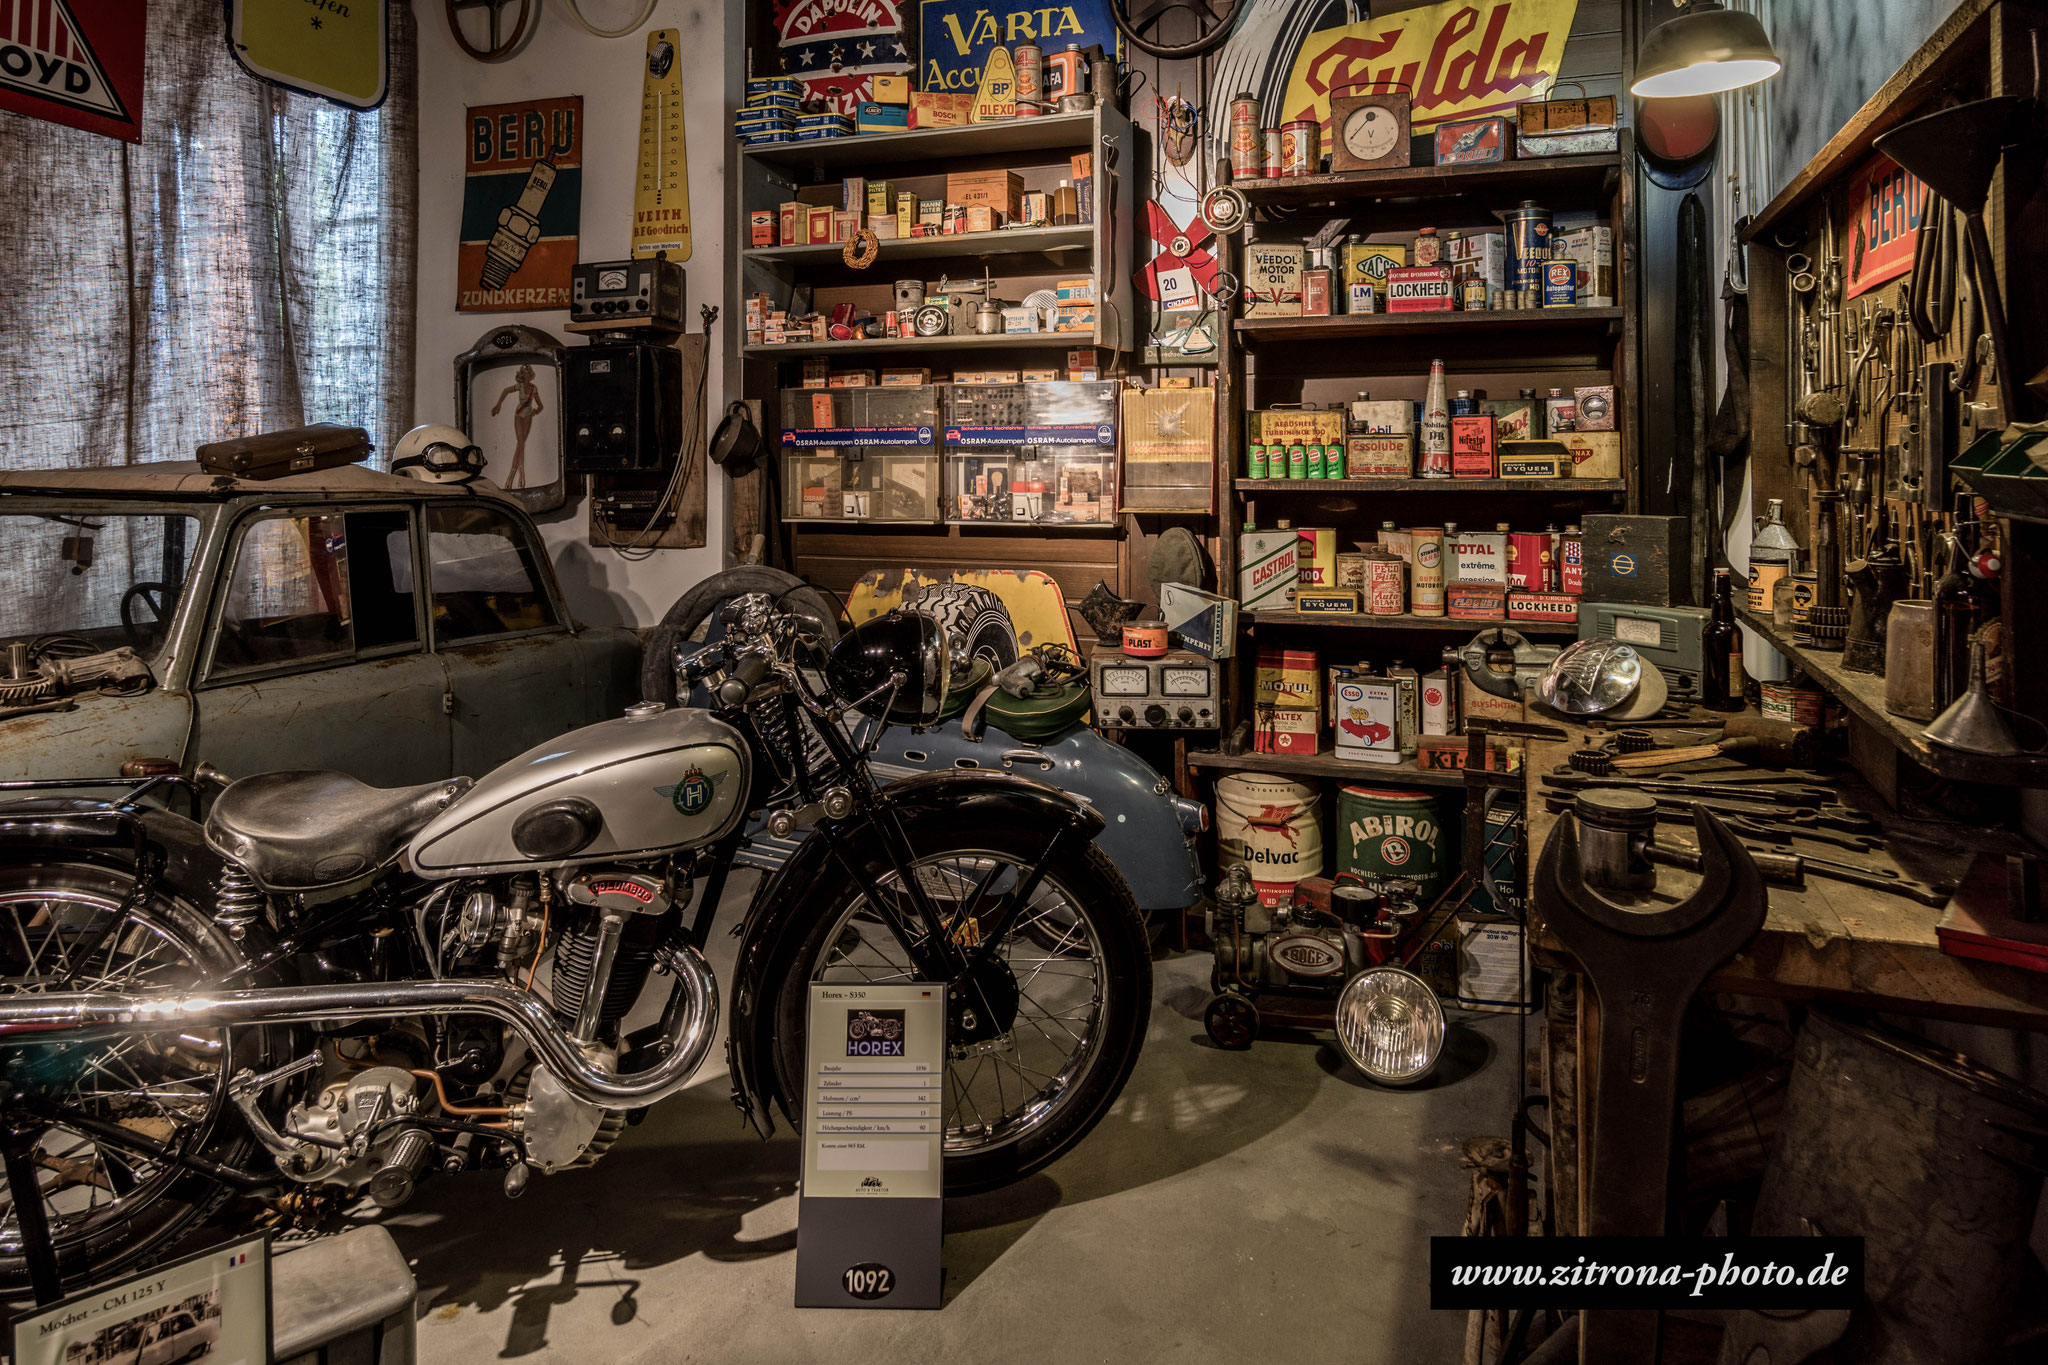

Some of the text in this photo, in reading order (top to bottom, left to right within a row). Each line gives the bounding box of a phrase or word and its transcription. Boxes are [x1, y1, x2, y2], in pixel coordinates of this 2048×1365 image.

[943, 6, 1085, 56] VARTA
[1297, 3, 1551, 112] Fulda
[992, 82, 1010, 95] BP
[933, 110, 957, 120] BOSCH
[980, 104, 1015, 116] OLEXO
[473, 109, 575, 164] BERU
[638, 208, 681, 222] VEITH
[1869, 166, 1926, 253] BERU
[1256, 255, 1297, 264] VEEDOL
[1260, 266, 1295, 274] MOTOR
[1551, 268, 1568, 277] REX
[1163, 277, 1178, 291] 20
[1269, 275, 1286, 283] OIL
[1354, 287, 1371, 298] LM
[1390, 282, 1449, 298] LOCKHEED
[1167, 299, 1194, 308] CINZANO
[1366, 425, 1392, 434] obil
[1352, 440, 1404, 451] Essolube
[1449, 544, 1495, 555] TOTAL
[1253, 550, 1296, 586] CASTROL
[1375, 565, 1399, 573] PECO
[1565, 566, 1582, 576] ANT
[1375, 591, 1399, 600] Auto
[1511, 602, 1572, 612] LOCKHEED
[1128, 639, 1152, 648] PLAST
[1177, 633, 1212, 651] EMPERIT
[1260, 680, 1312, 694] MOTUL
[1344, 689, 1360, 697] ESSO
[1274, 713, 1303, 721] ALTEX
[1350, 814, 1439, 849] ABIROL
[1244, 846, 1299, 864] Delvac
[591, 881, 652, 902] COLUMBUS
[822, 991, 866, 999] Horex S350
[848, 1041, 902, 1055] HOREX
[845, 1269, 889, 1293] 1092
[39, 1279, 168, 1336] Mochet CM 125 Y
